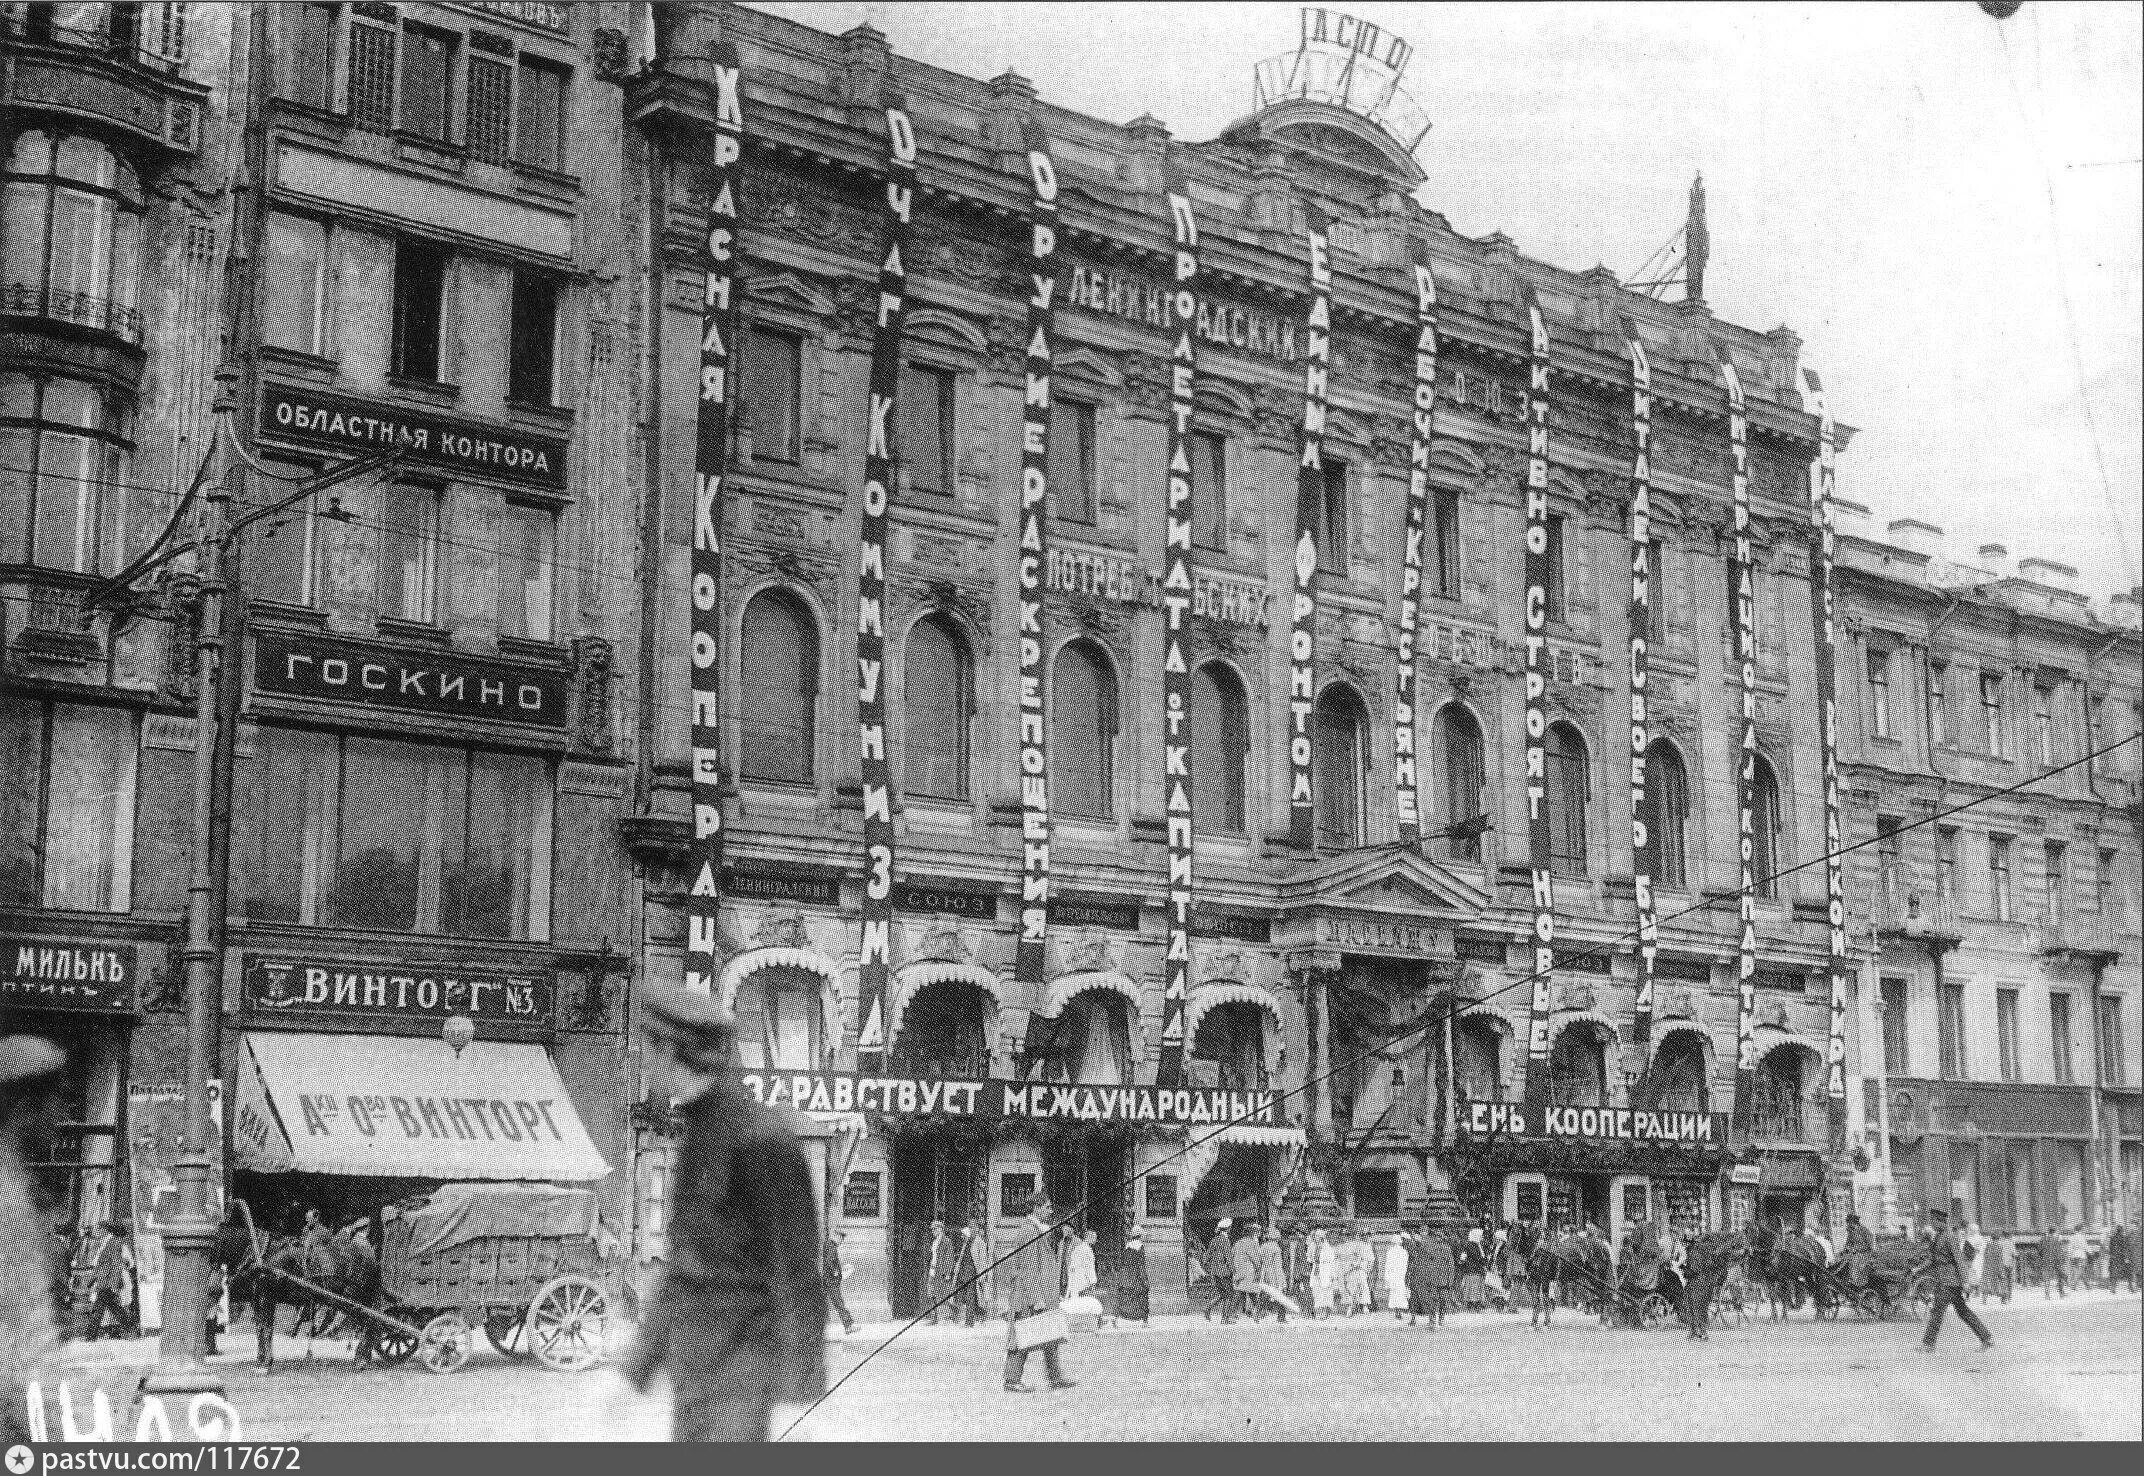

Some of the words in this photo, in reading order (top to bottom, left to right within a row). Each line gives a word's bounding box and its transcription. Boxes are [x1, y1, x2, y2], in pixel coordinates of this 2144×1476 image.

[702, 64, 743, 403] КРАСНАЯ
[878, 107, 916, 328] ОЧАГ
[1024, 151, 1058, 454] ОРУДИЕ
[277, 401, 429, 449] ОБЛАСТНАЯ
[441, 432, 549, 473] КОНТОРА
[1069, 267, 1296, 361] ЛЕНИНГАДСКИЙ
[1454, 370, 1528, 422] ОЮЗ
[1165, 193, 1197, 673] ПРОЛЕТАРИАТА
[1410, 264, 1437, 498] РАБОЧИЕ
[1527, 307, 1549, 555] АКТИВНО
[1627, 338, 1651, 607] ЦИТАДЕЛИ
[286, 653, 542, 709] ГОСКИНО
[685, 472, 721, 998] КООПЕРАЦИ
[858, 394, 893, 1051] КОММУНИЗМА
[1020, 468, 1049, 942] РАСКРЕПОЩЕНИЯ
[1291, 529, 1317, 807] ФРОНТОМ
[1396, 527, 1424, 825] КРЕСТЬЯНЕ
[1526, 585, 1545, 820] СТРОЯТ
[1631, 638, 1647, 848] СВОЕГО
[907, 892, 985, 912] СОЮЗ
[1163, 746, 1191, 1046] КАПИТАЛА
[1530, 869, 1553, 1060] НОВЫЕ
[1635, 875, 1658, 1012] БЫТА
[391, 1095, 562, 1142] ВИНТОРГ
[742, 1075, 984, 1114] ЗДРАВСТВУЕТ
[1003, 1084, 1273, 1124] МЕЖДУНАРОДНЫЙ
[1461, 1103, 1525, 1133] ЕНЬ
[1545, 1107, 1712, 1142] КООПЕРАЦИИ
[1829, 975, 1845, 1098] МИРА
